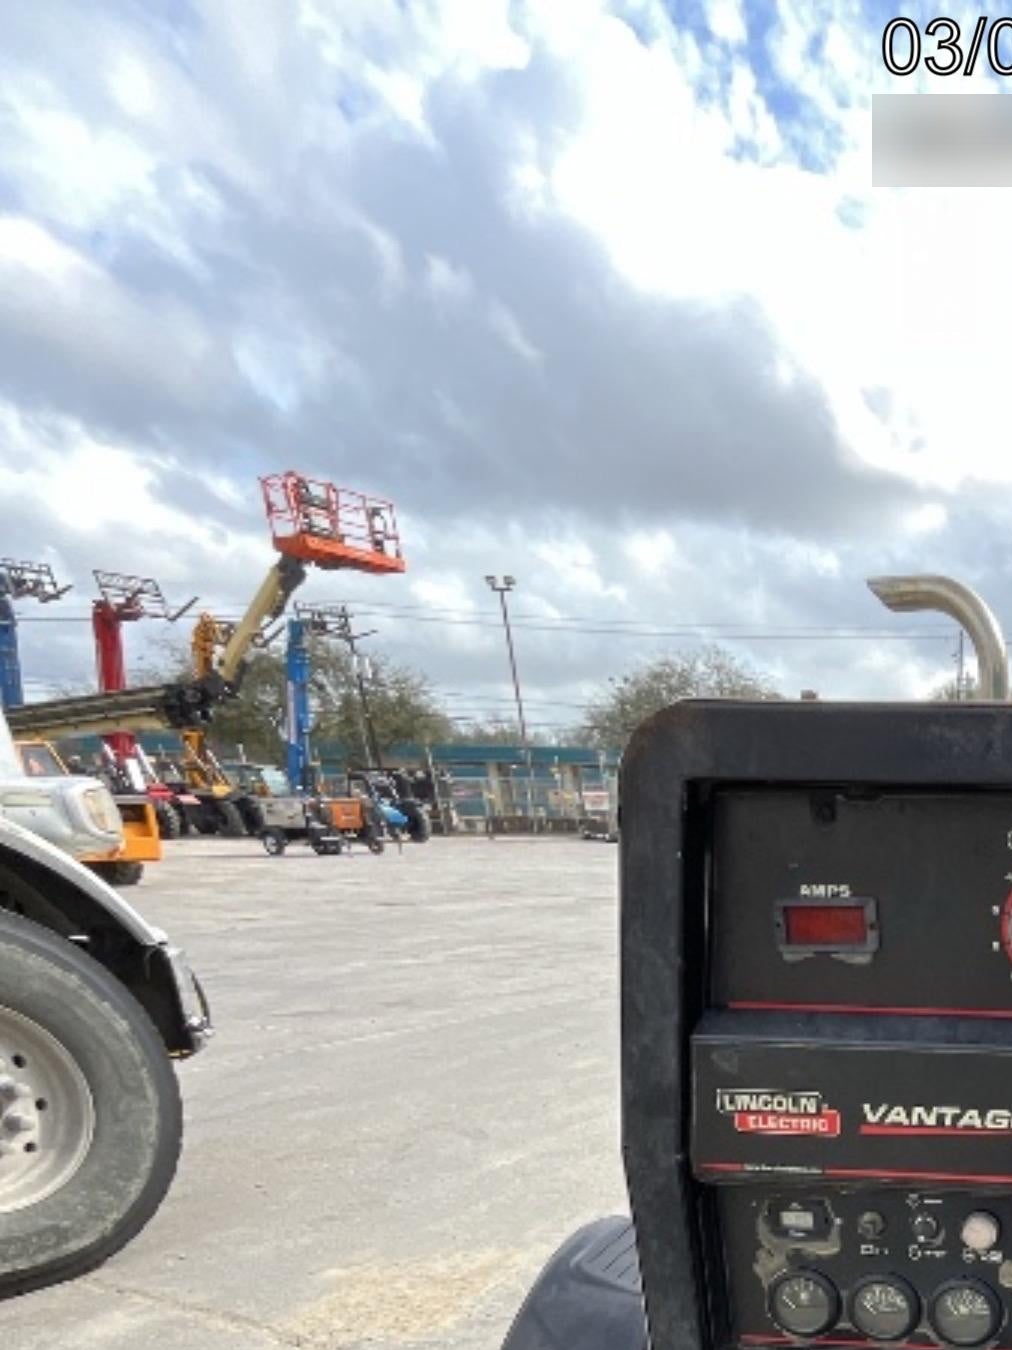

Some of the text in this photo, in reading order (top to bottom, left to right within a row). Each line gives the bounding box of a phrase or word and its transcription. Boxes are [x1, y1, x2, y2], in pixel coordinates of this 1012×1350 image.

[800, 884, 851, 898] AMPS
[724, 1093, 817, 1113] LINCOLN
[747, 1115, 828, 1132] ELECTRIC
